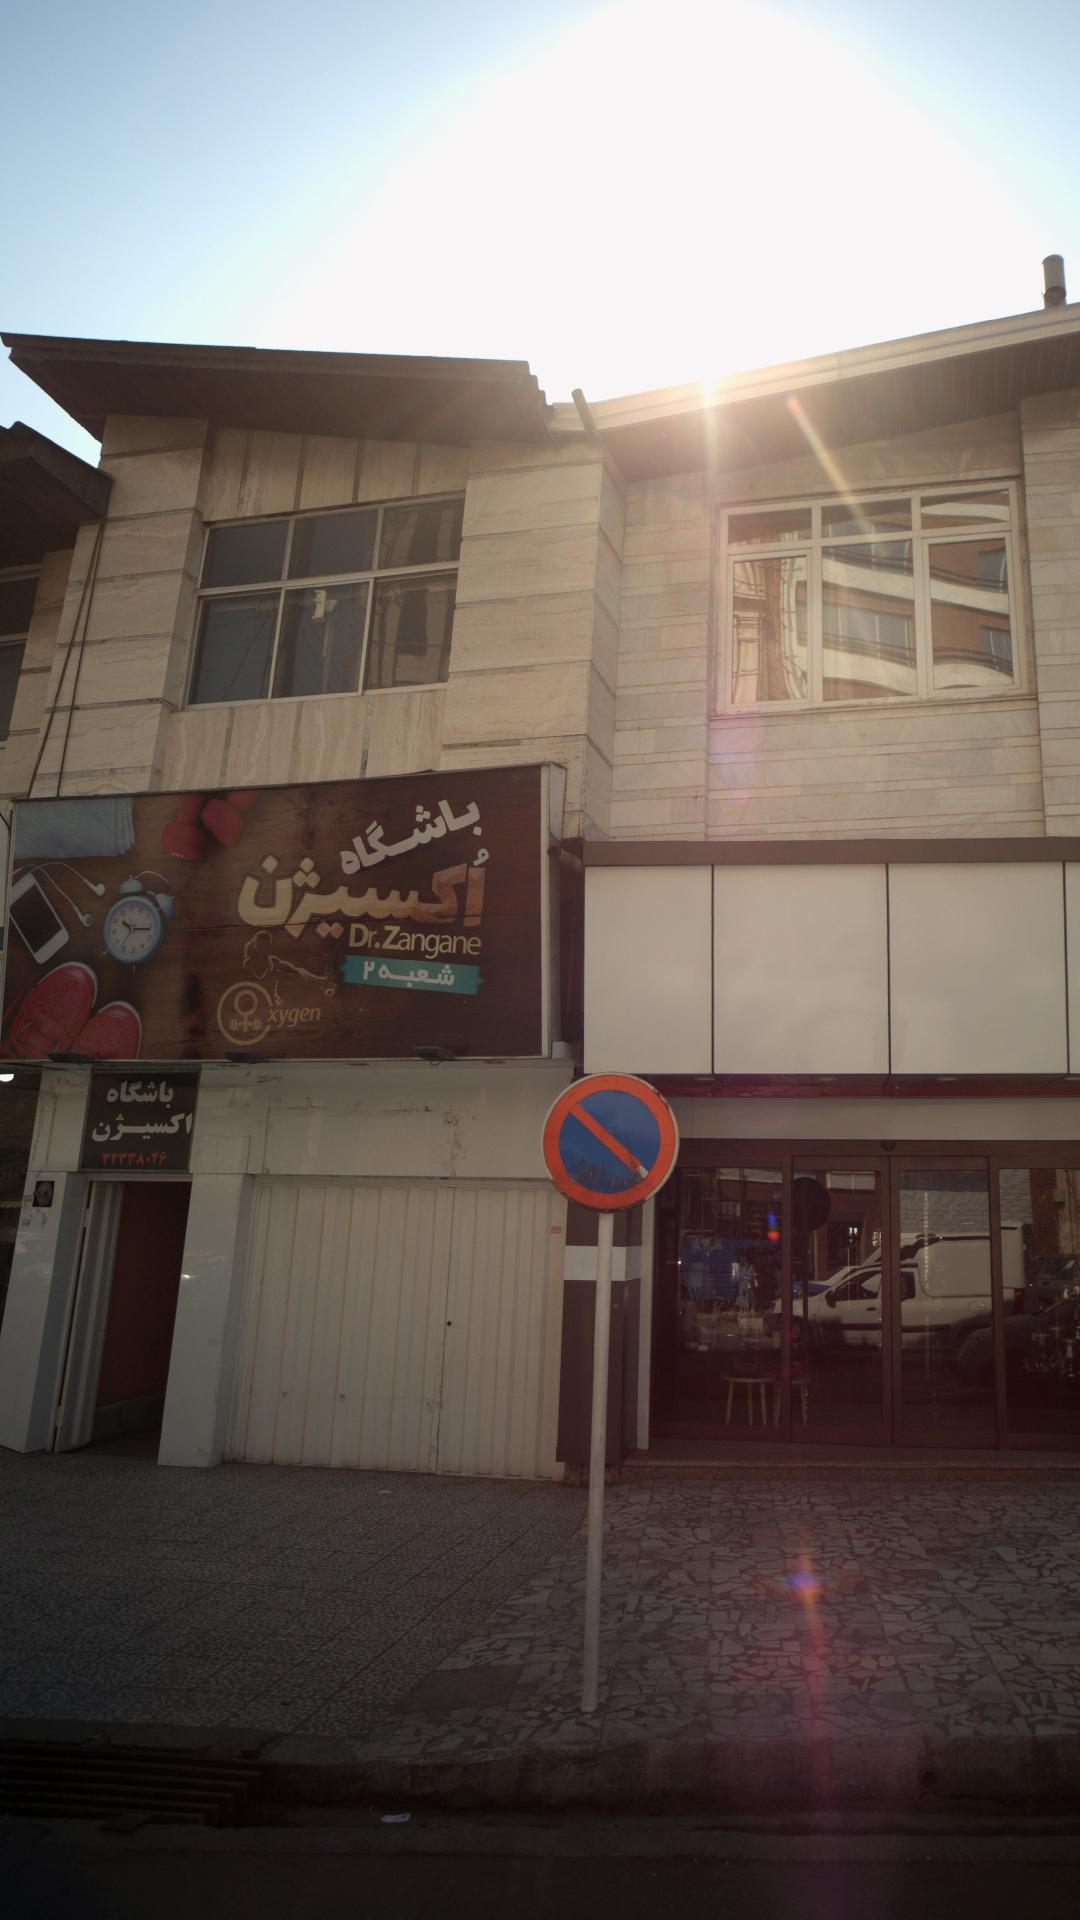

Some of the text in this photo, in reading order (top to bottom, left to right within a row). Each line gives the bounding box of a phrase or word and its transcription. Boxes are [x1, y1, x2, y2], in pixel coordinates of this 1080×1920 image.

[340, 799, 483, 875] باشگاه
[378, 963, 456, 988] شعبه
[106, 1080, 175, 1109] باشگاه
[91, 1113, 193, 1142] اکسیژن
